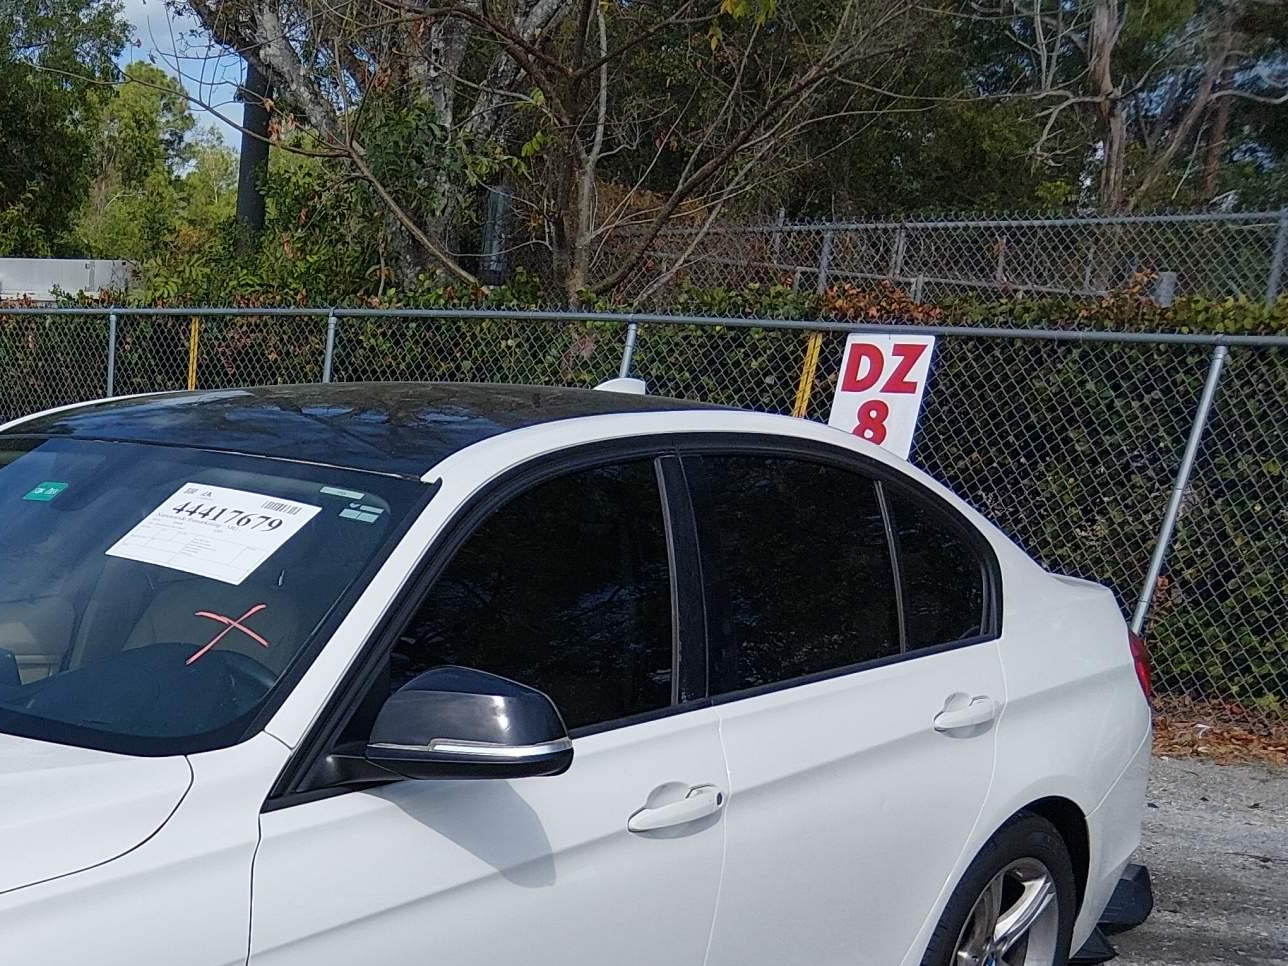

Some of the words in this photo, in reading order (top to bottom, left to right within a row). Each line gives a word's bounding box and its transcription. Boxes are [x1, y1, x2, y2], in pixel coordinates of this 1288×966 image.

[841, 343, 928, 394] DZ
[852, 400, 889, 446] 8
[172, 501, 283, 532] 44417679
